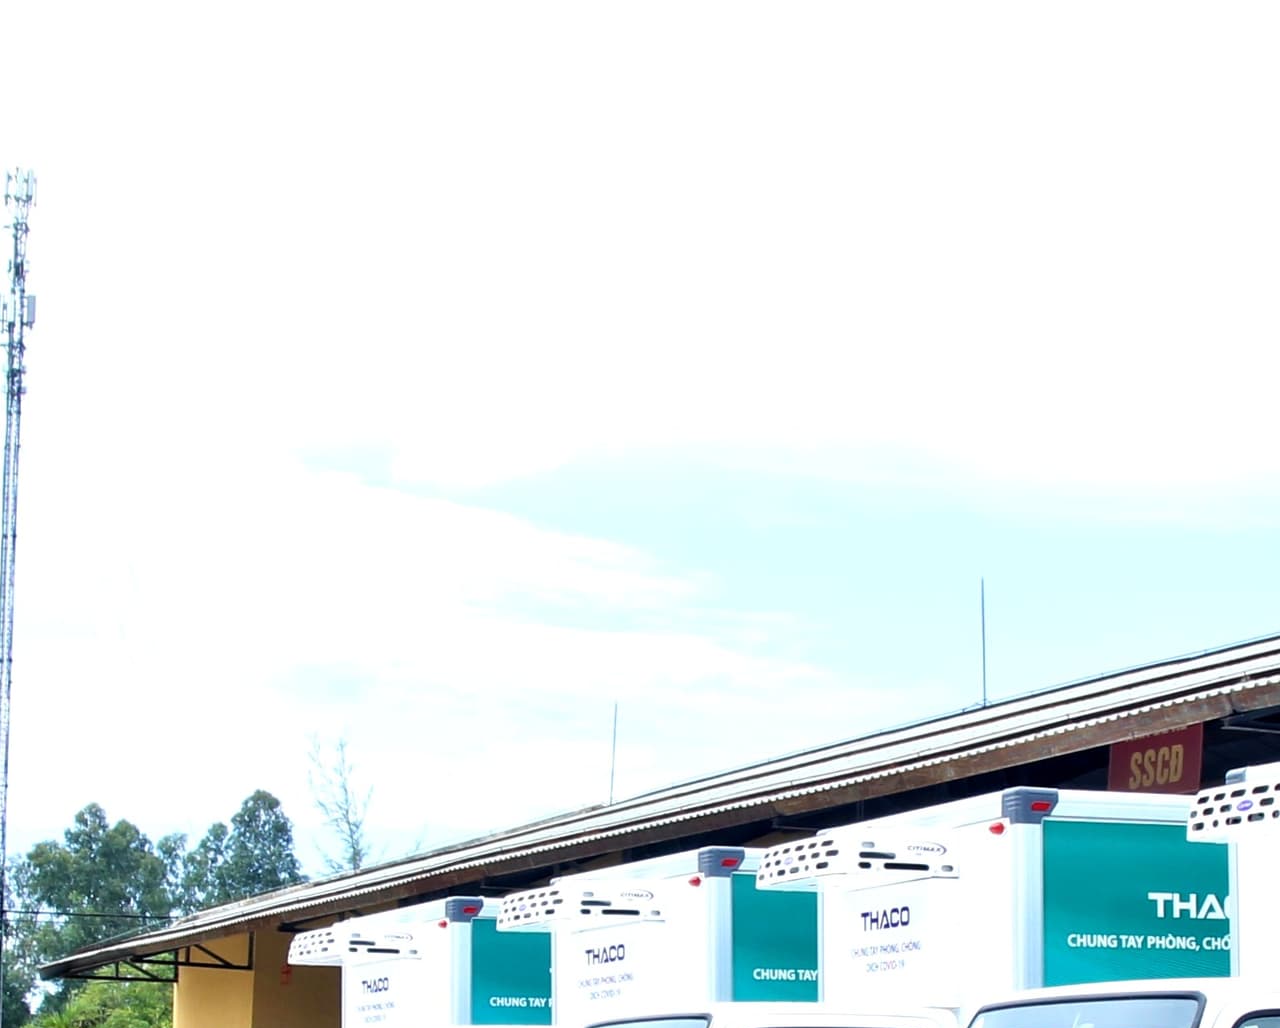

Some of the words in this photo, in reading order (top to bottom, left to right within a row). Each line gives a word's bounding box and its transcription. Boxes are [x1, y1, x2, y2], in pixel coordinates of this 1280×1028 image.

[1147, 892, 1230, 920] THA
[860, 906, 910, 932] THACO
[1067, 933, 1117, 949] CHUNG
[1119, 934, 1144, 949] TAY
[1146, 933, 1201, 952] PHÒNG,
[584, 943, 625, 966] THACO
[753, 968, 796, 981] CHUNG
[797, 969, 819, 981] TAY
[489, 996, 527, 1007] CHUNG
[528, 997, 547, 1007] TAY
